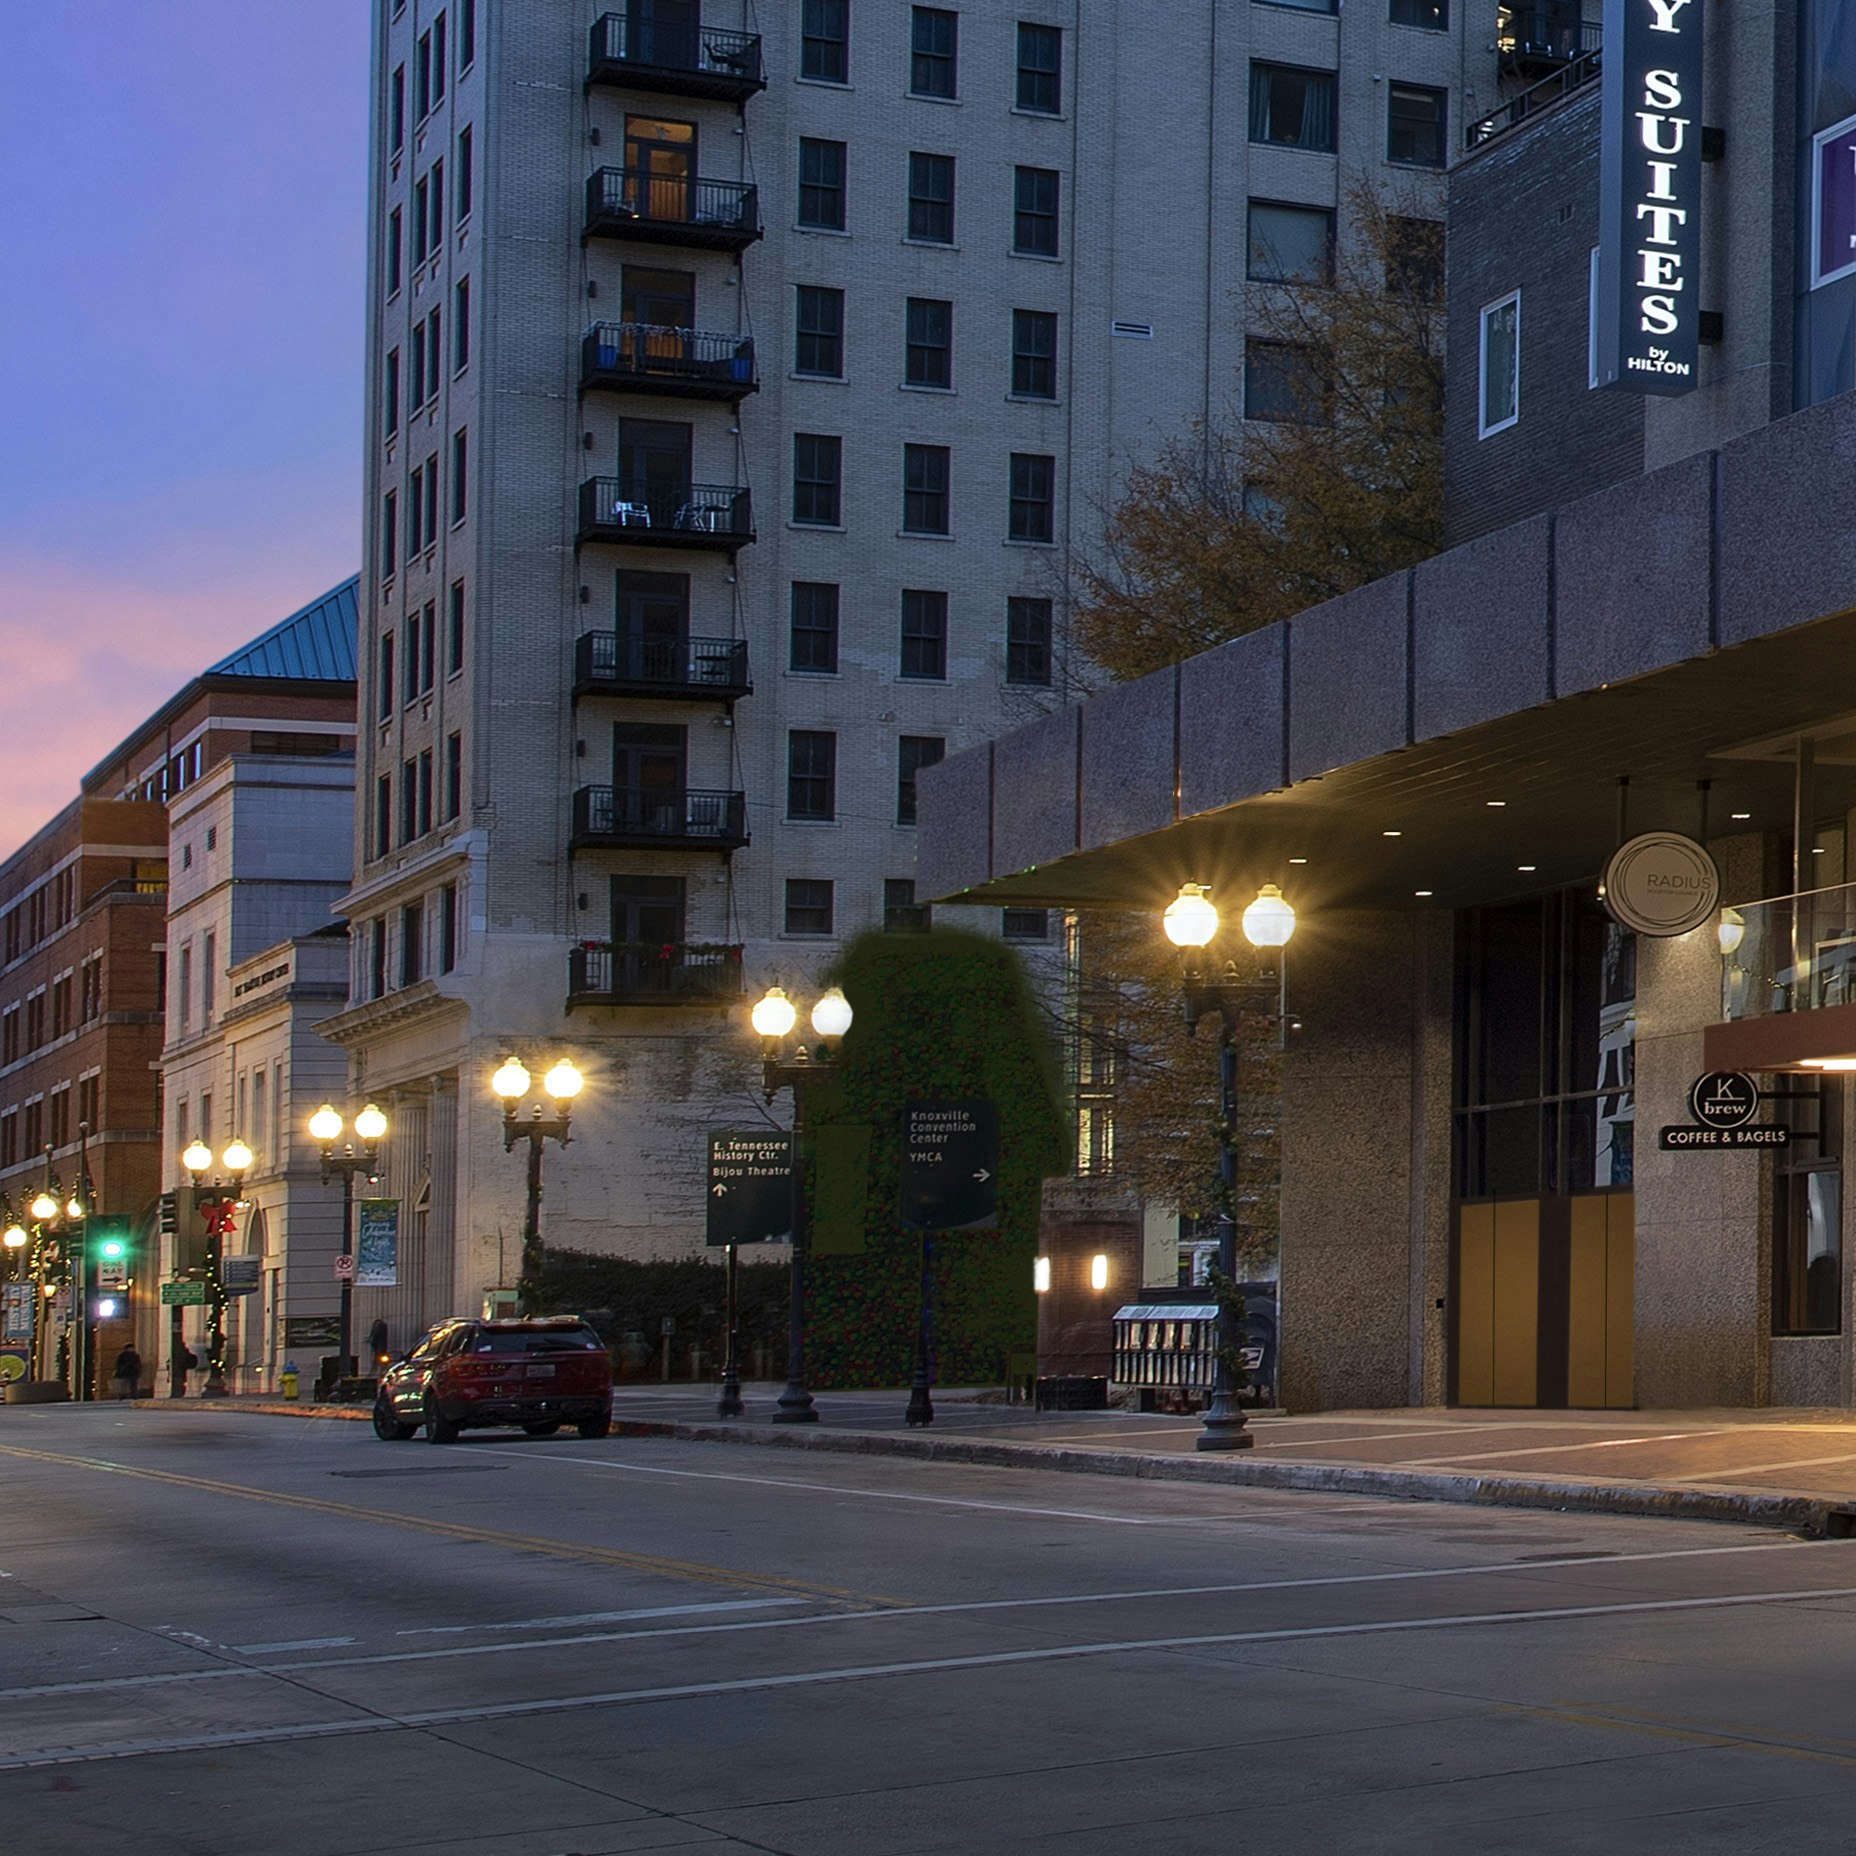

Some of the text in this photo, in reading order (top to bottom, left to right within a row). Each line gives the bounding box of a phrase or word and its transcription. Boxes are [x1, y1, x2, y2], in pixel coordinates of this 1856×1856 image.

[1635, 69, 1691, 335] SUITES
[1648, 345, 1669, 362] by
[1627, 356, 1690, 376] HILTON
[1647, 874, 1712, 890] RADIUS
[1717, 1077, 1734, 1099] K
[1704, 1101, 1747, 1115] brew
[910, 1110, 970, 1121] Knoxville
[910, 1121, 977, 1133] Convention
[909, 1133, 949, 1144] Center
[1667, 1130, 1786, 1144] COFFEE & BAGELS
[713, 1141, 789, 1151] E. Tennessee
[713, 1150, 779, 1162] History Ctr.
[908, 1151, 943, 1162] YMCA
[712, 1166, 791, 1179] Bijou Theatre
